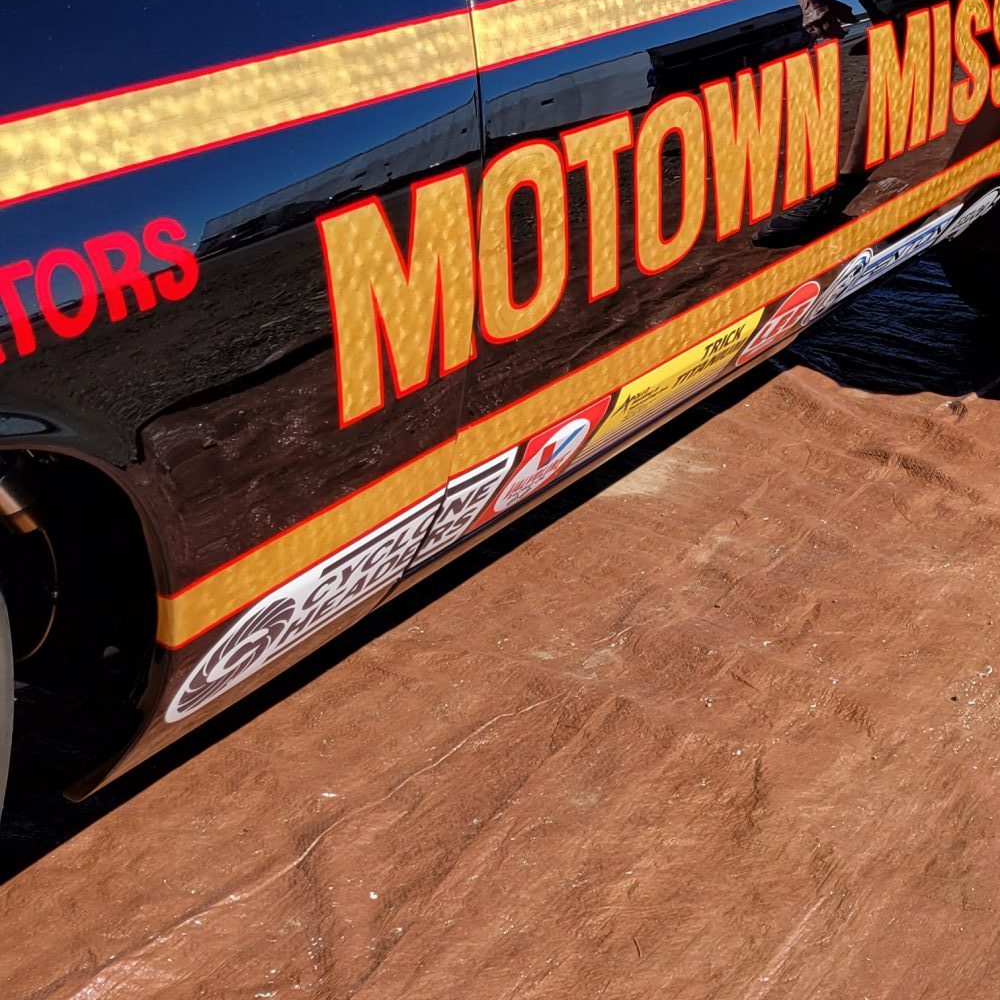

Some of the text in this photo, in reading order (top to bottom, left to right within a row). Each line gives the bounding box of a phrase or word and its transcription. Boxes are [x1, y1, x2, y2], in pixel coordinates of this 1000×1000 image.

[0, 216, 199, 366] TORS
[315, 37, 842, 430] MOTOWN
[672, 336, 749, 389] TITANIUM
[701, 323, 746, 360] TRICK
[279, 510, 482, 645] HEADERS
[301, 475, 502, 613] CYCLONE
